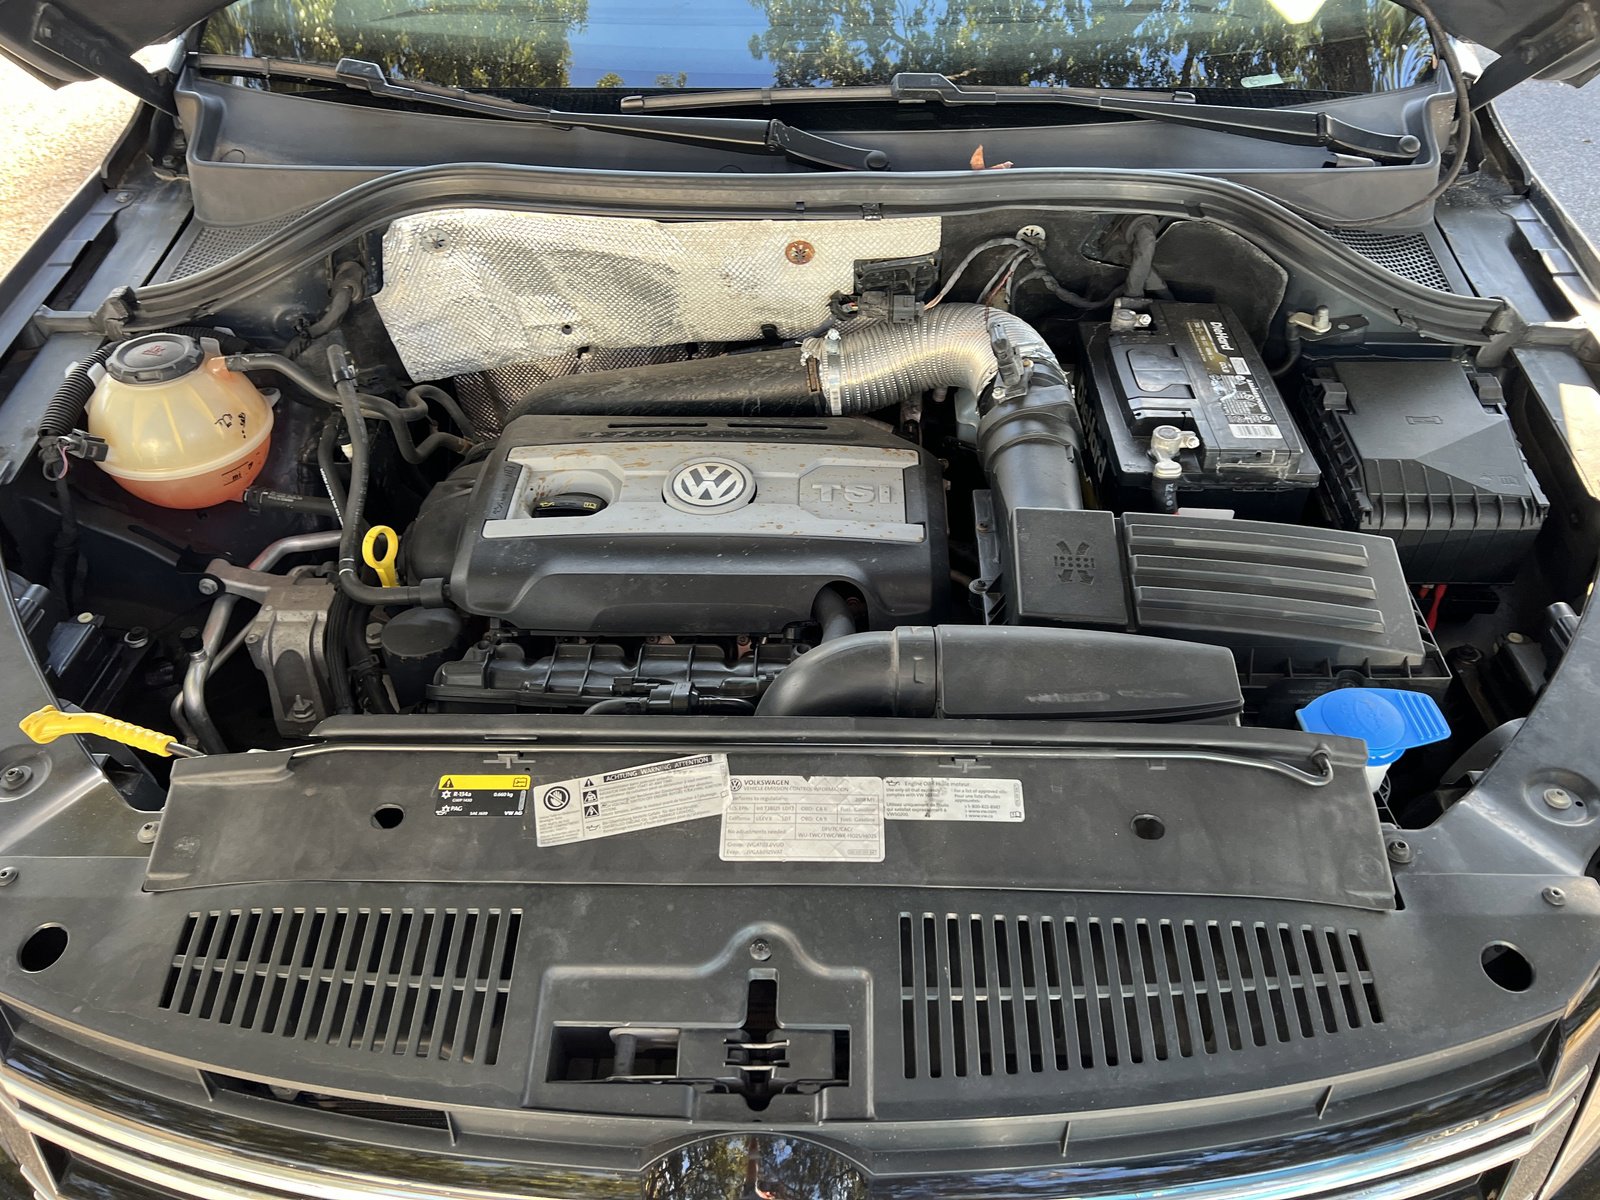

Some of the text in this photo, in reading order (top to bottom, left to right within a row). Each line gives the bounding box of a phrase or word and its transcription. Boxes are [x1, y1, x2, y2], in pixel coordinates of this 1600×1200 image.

[1209, 321, 1235, 351] DieHard
[811, 483, 892, 504] TSI
[605, 757, 709, 781] ACHTUNG WARNING ATTENTION
